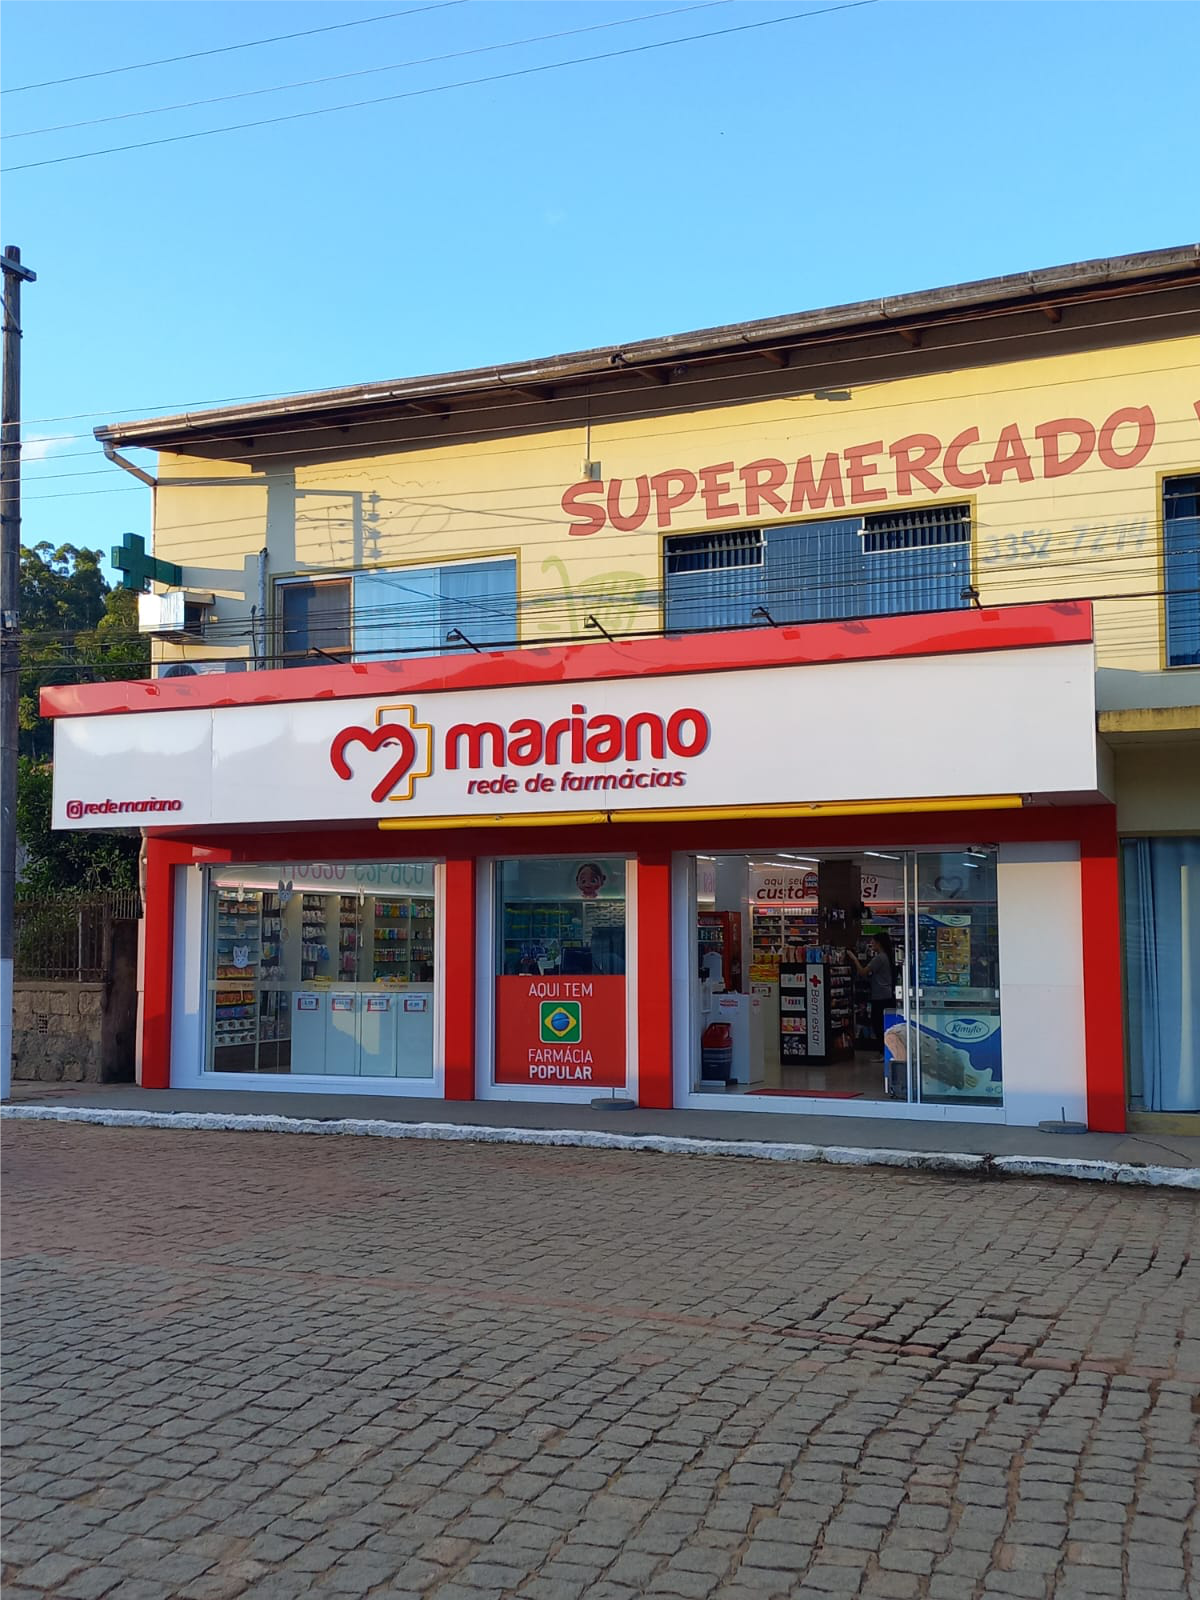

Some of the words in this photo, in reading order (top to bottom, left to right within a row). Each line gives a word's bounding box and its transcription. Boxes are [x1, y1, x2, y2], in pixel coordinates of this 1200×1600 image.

[561, 405, 1156, 536] SUPERMERCADO
[445, 704, 710, 770] mariano
[467, 774, 517, 805] rede
[525, 771, 555, 803] de
[560, 768, 686, 802] farmácias
[528, 983, 560, 998] AQUI
[564, 983, 593, 997] TEM
[811, 989, 820, 1015] Bem
[812, 1017, 821, 1046] estar
[528, 1046, 593, 1064] FARMÁCIA
[529, 1066, 592, 1080] POPULAR
